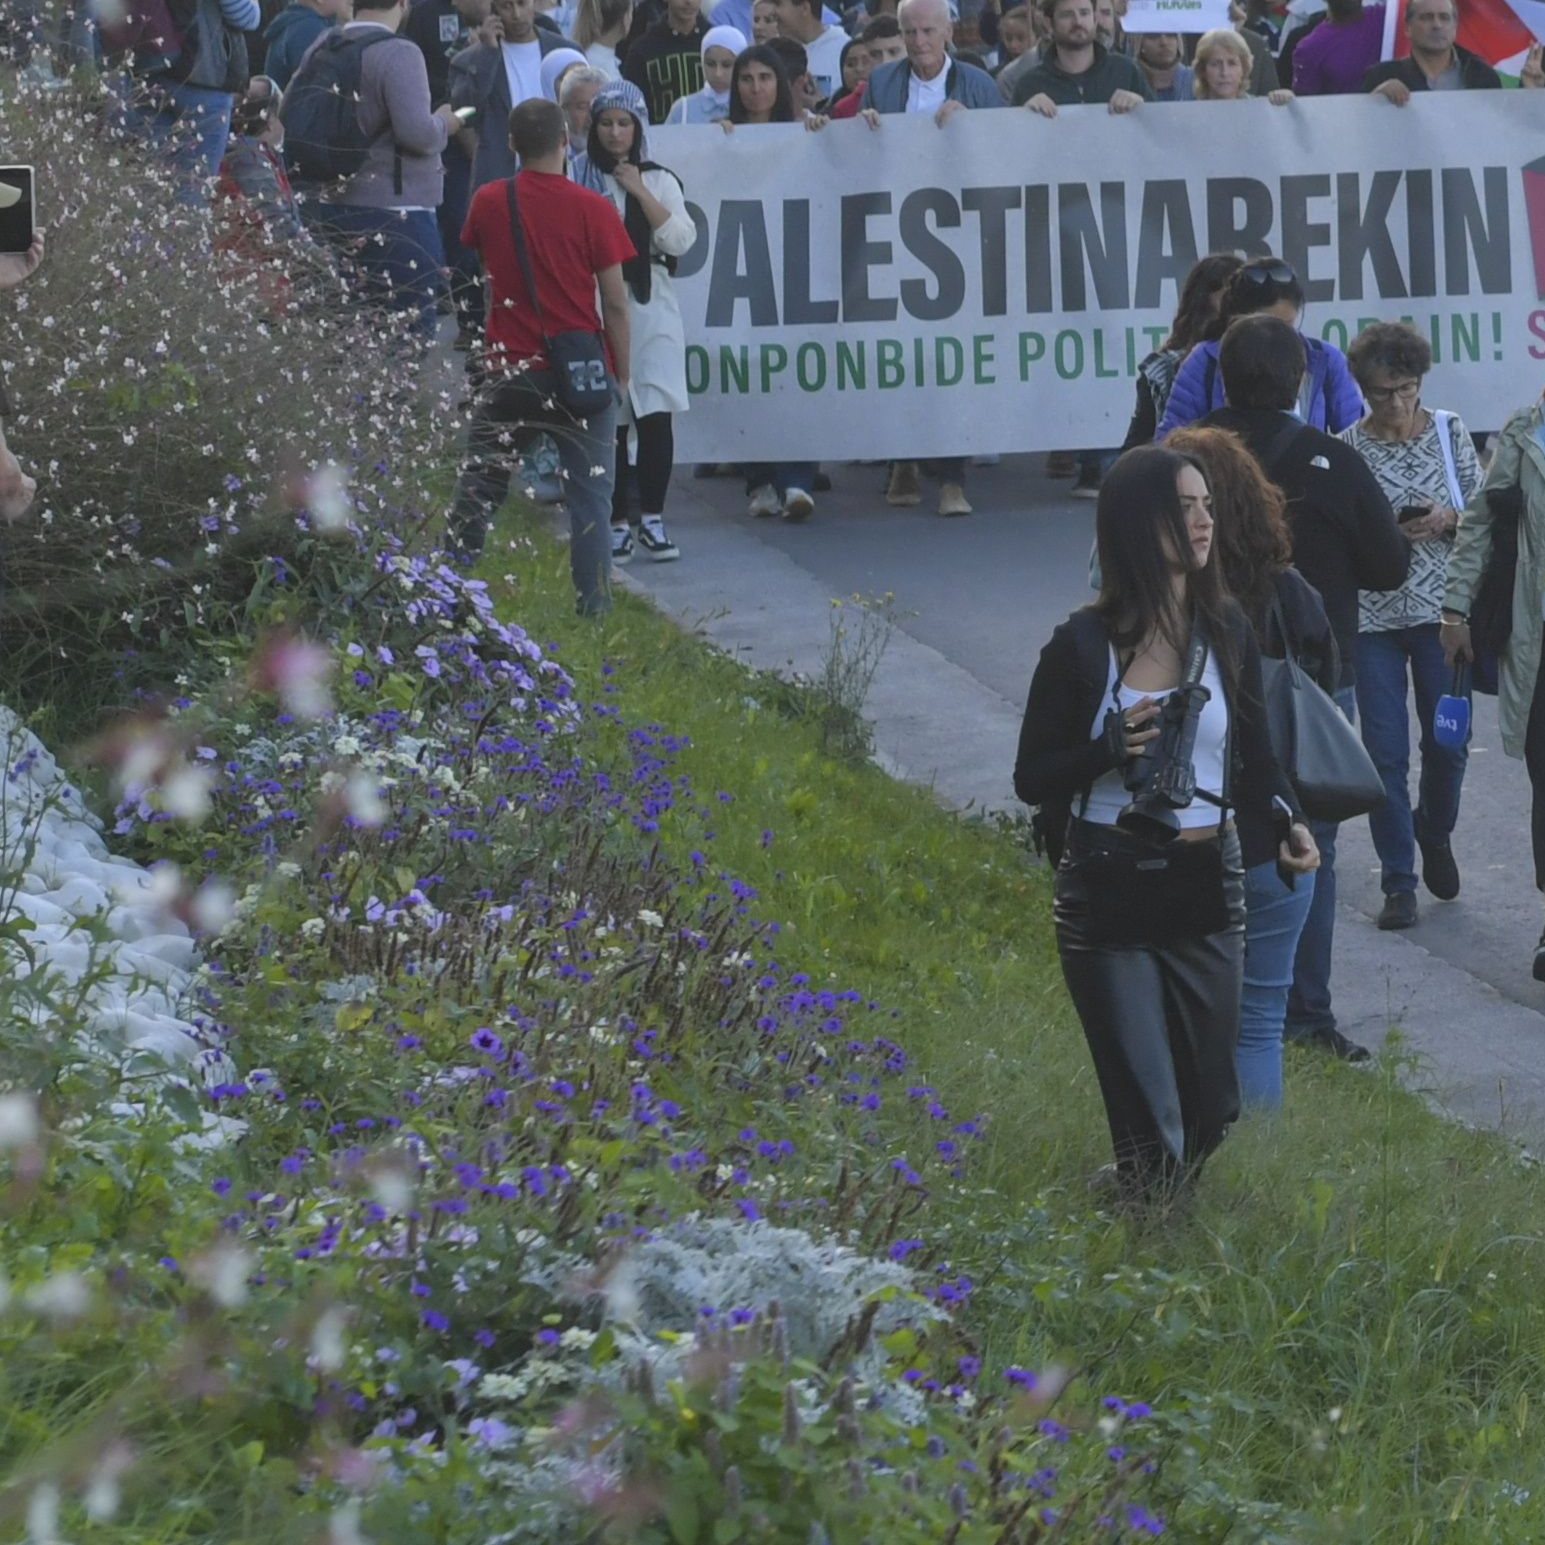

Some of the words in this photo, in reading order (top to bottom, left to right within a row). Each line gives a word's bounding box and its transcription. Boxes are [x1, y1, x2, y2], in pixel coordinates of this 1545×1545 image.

[686, 334, 996, 394] ONPONBIDE
[1019, 326, 1168, 383] POLIT
[1322, 311, 1502, 363] OIN!
